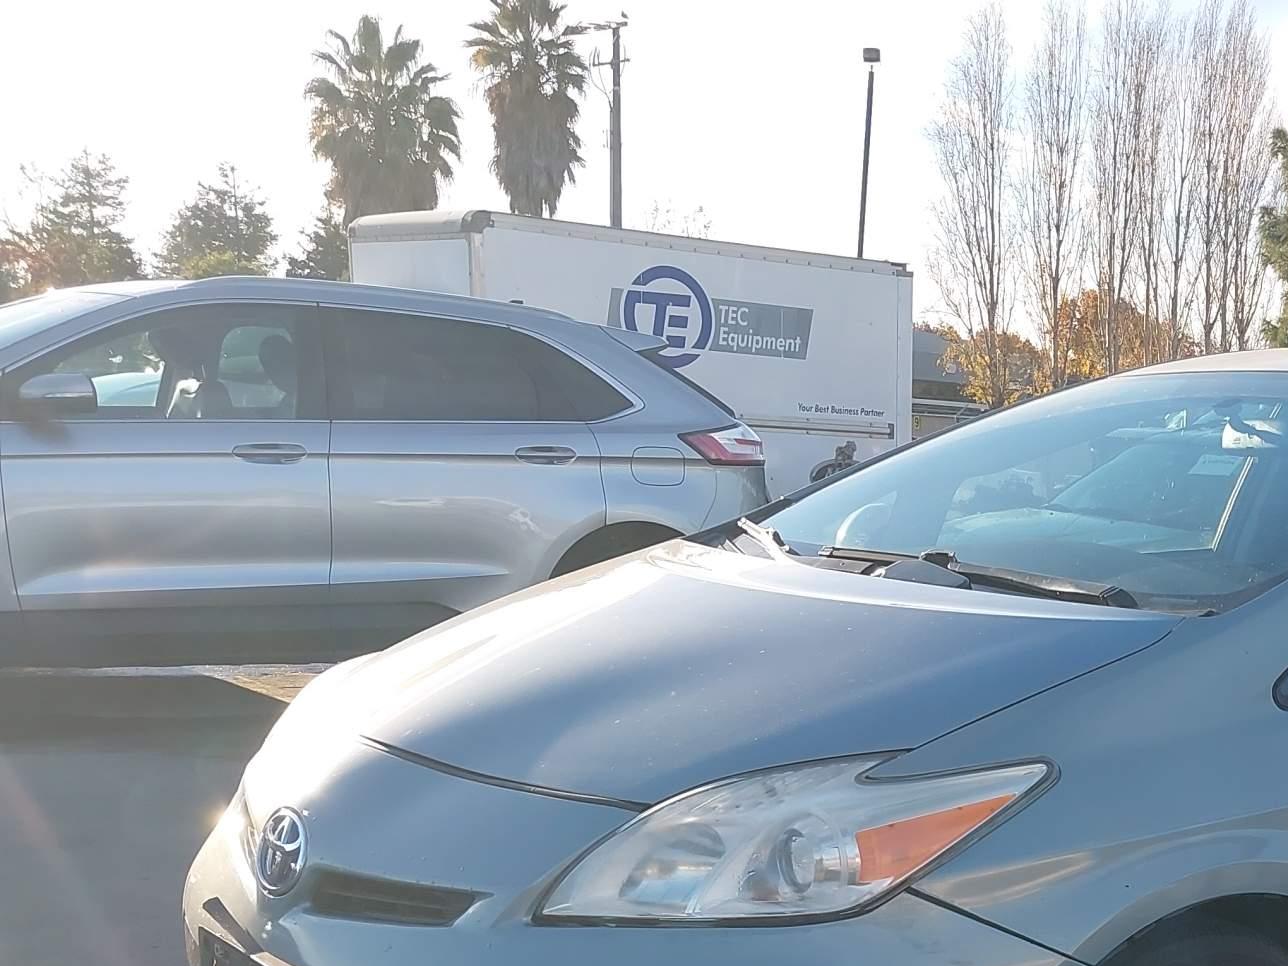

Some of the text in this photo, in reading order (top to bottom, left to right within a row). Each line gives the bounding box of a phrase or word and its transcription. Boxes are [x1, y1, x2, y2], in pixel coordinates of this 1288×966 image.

[718, 305, 749, 326] TEC
[718, 327, 802, 353] Equipment
[797, 402, 885, 418] Your Best Business Partner
